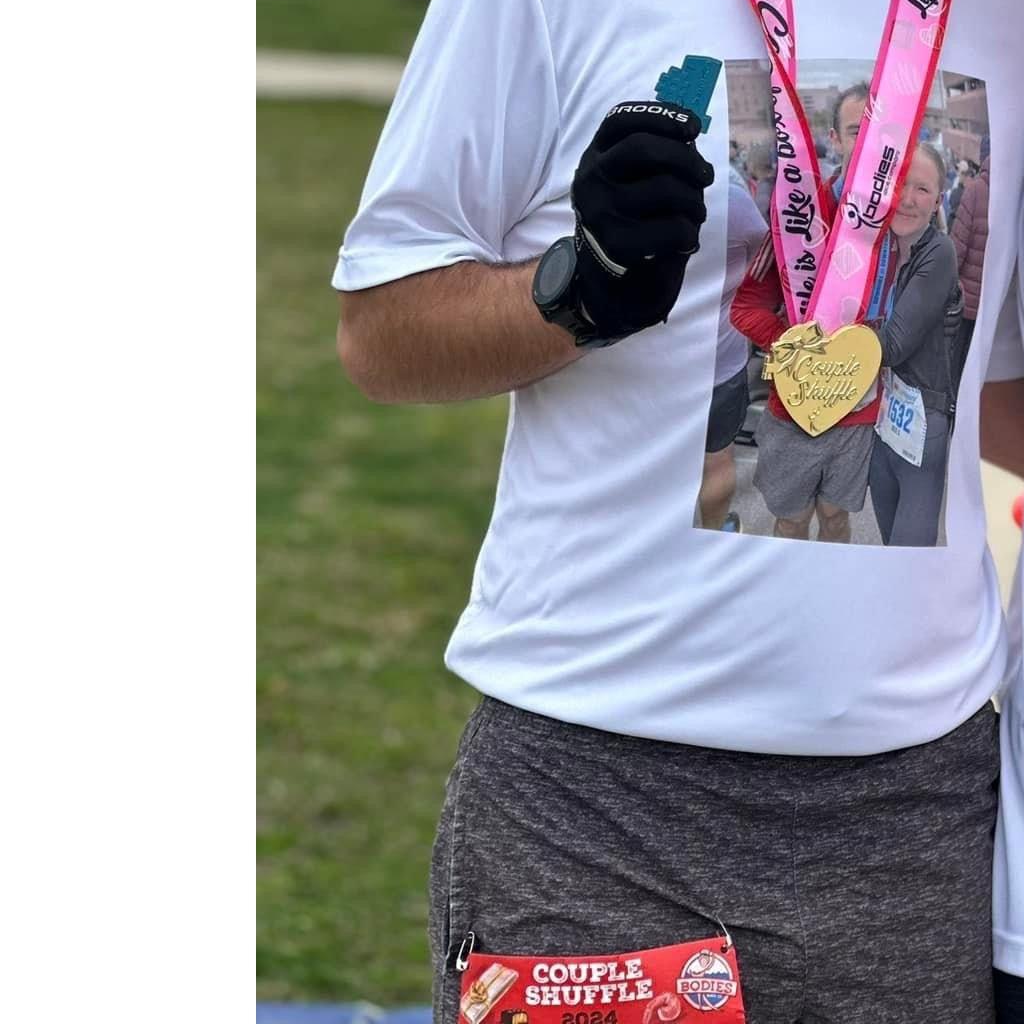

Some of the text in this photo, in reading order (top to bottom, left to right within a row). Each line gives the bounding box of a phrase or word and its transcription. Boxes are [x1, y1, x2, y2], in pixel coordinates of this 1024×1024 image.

[607, 104, 690, 124] BROOKS
[783, 163, 802, 184] a
[863, 145, 895, 220] bodies
[781, 189, 815, 242] Like
[794, 250, 817, 272] is
[792, 353, 862, 381] Couple
[787, 378, 858, 408] Shuffle
[887, 395, 915, 435] 1532
[532, 958, 643, 984] COUPLE
[525, 978, 653, 1007] SHUFFLE
[680, 980, 733, 994] BODIES
[562, 1009, 618, 1024] 2024
